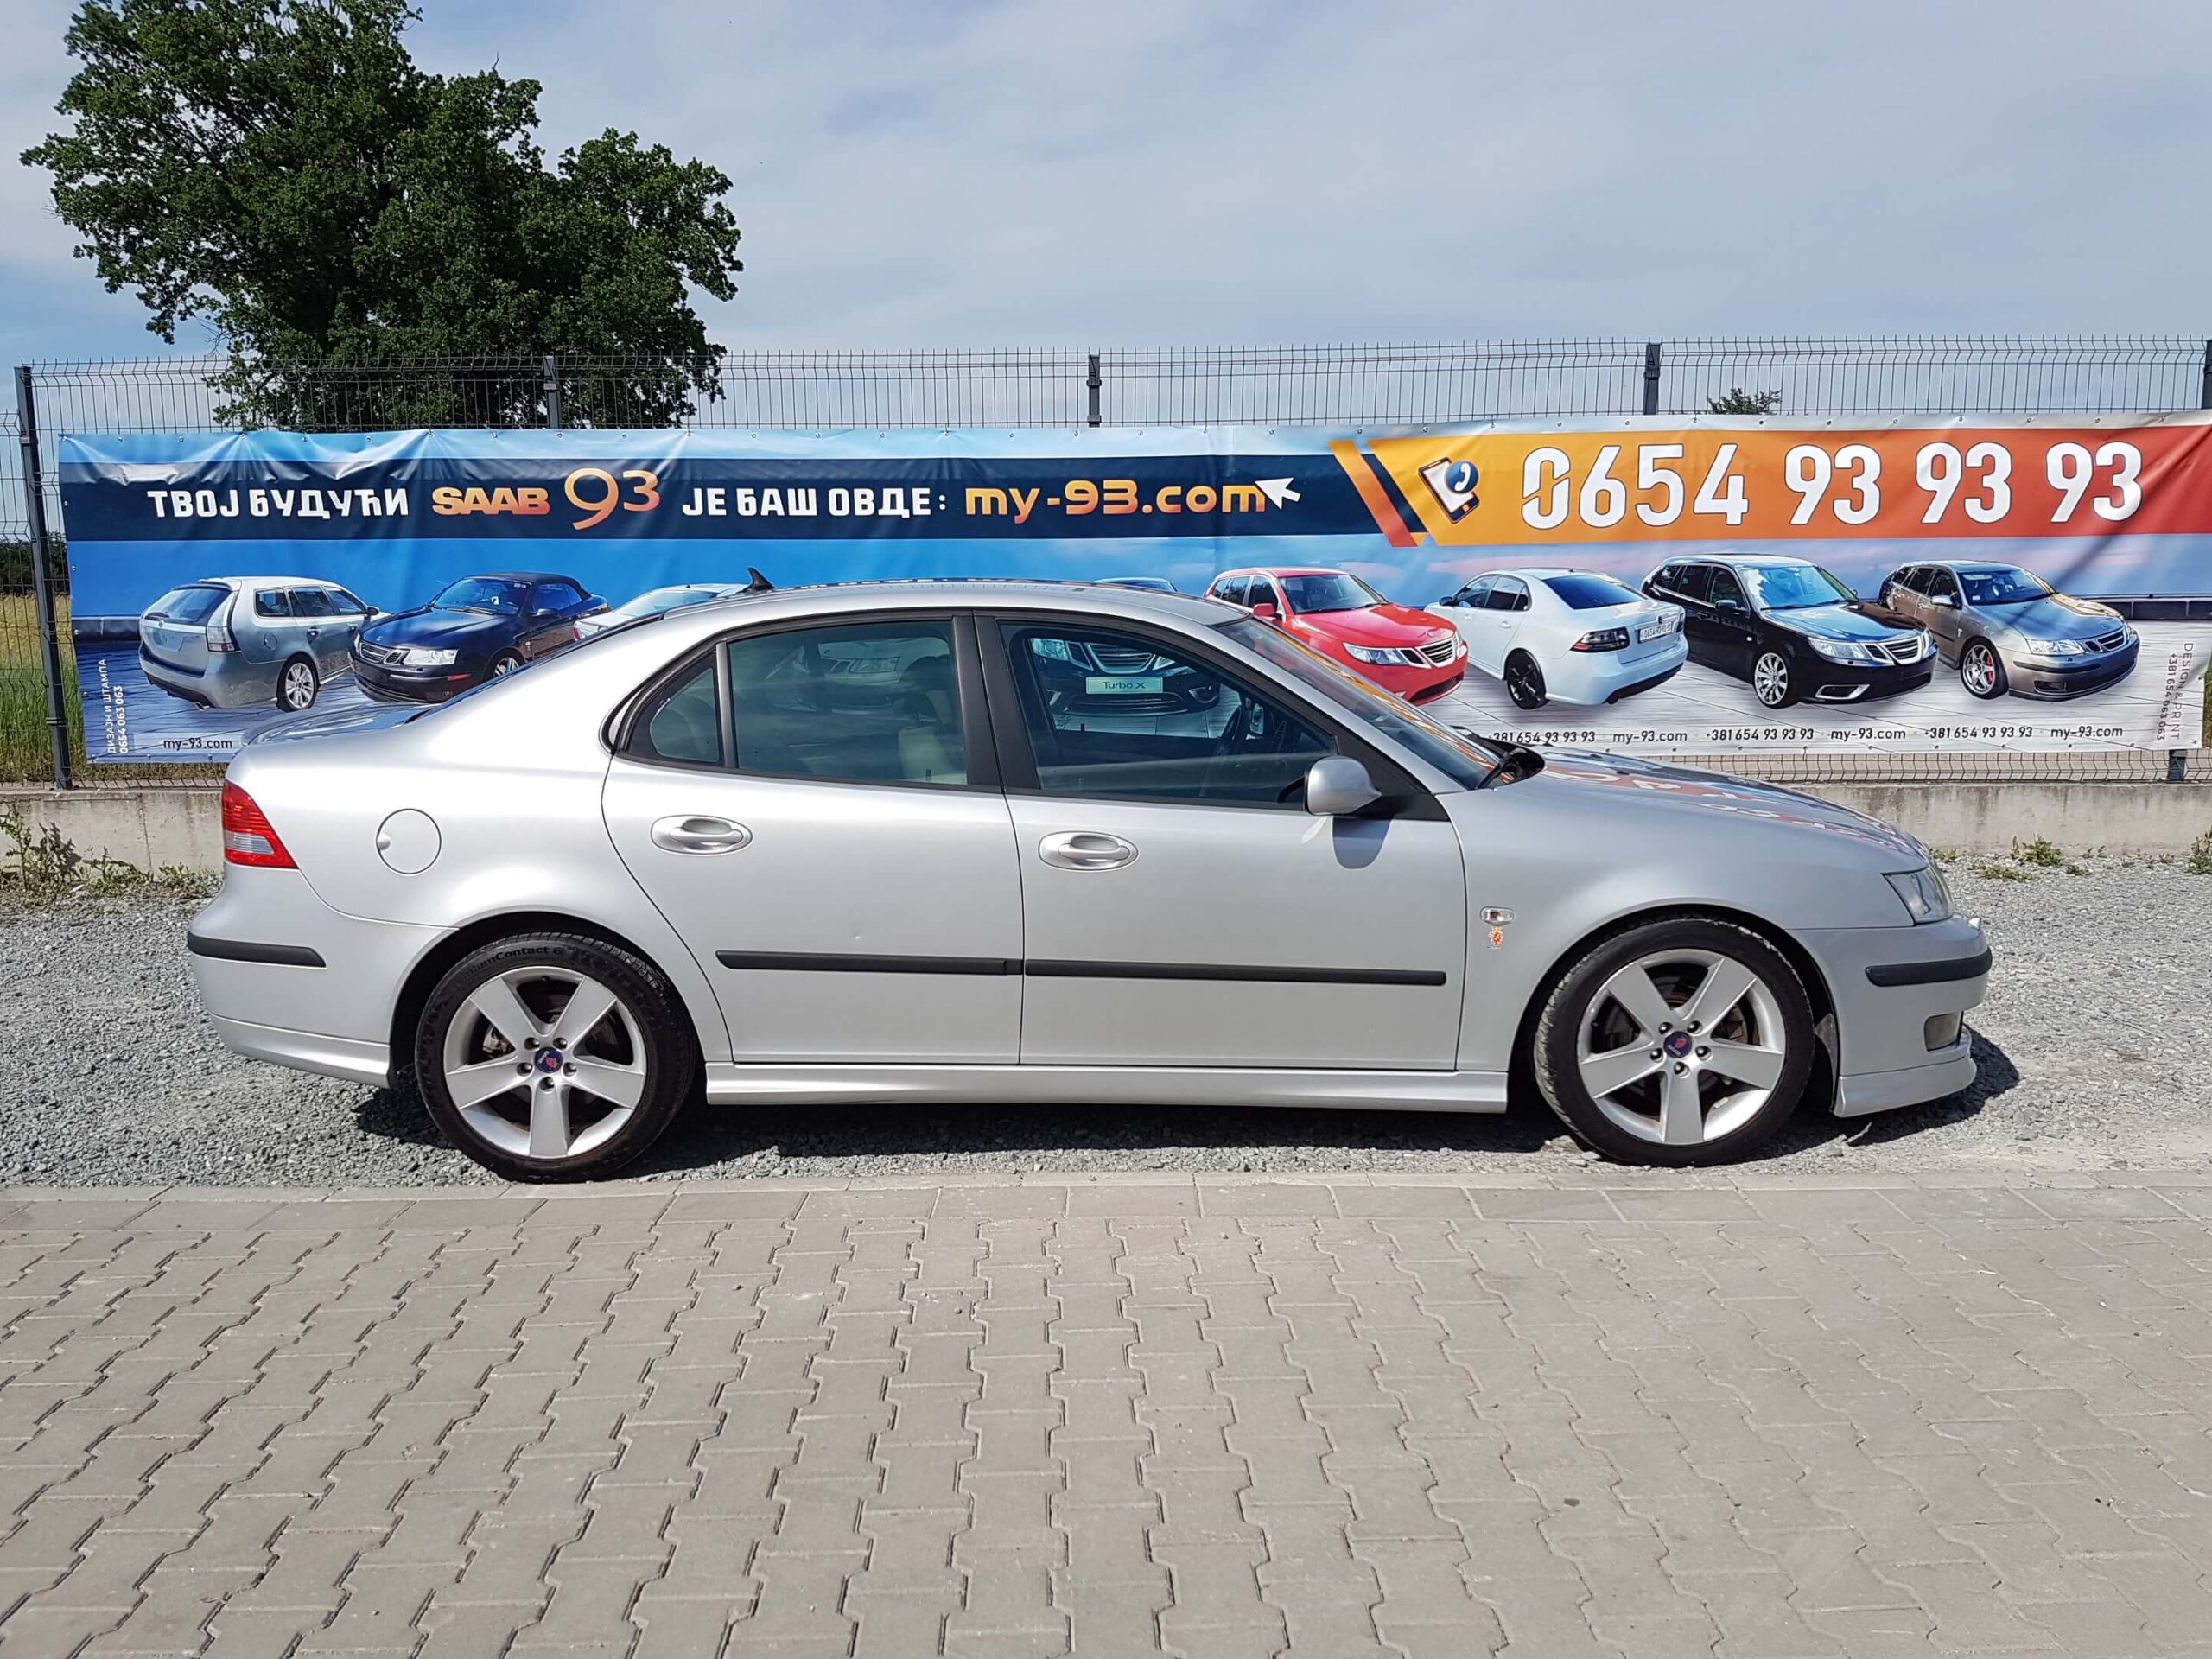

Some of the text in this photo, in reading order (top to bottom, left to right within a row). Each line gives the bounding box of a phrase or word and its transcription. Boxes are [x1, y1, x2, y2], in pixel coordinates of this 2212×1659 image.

[1521, 441, 2143, 530] 0654 93 93 93
[147, 489, 240, 518] ТВОЈ
[432, 486, 550, 515] SAAB
[564, 467, 660, 530] 93
[682, 487, 727, 517] ЈЕ
[736, 487, 817, 517] БАШ
[965, 479, 1266, 524] my-93.com
[2177, 642, 2194, 690] DESIGN
[99, 658, 111, 703] ШТАМПА
[1103, 681, 1134, 690] Turbo
[2157, 653, 2177, 741] +381 654 063 063
[113, 685, 128, 754] 0654 063 063
[2170, 703, 2182, 740] PRINT
[1517, 732, 1541, 743] 654
[1545, 732, 1559, 743] 93
[1563, 731, 1577, 742] 93
[1581, 731, 1595, 742] 93
[1612, 730, 1688, 745] my-93.com
[1706, 728, 1814, 741] +381 654 93 93 93
[1830, 728, 1906, 742] my-93.com
[1924, 726, 2032, 739] +381 654 93 93 93
[2050, 725, 2123, 740] my-93.com
[163, 737, 232, 751] my-93.com
